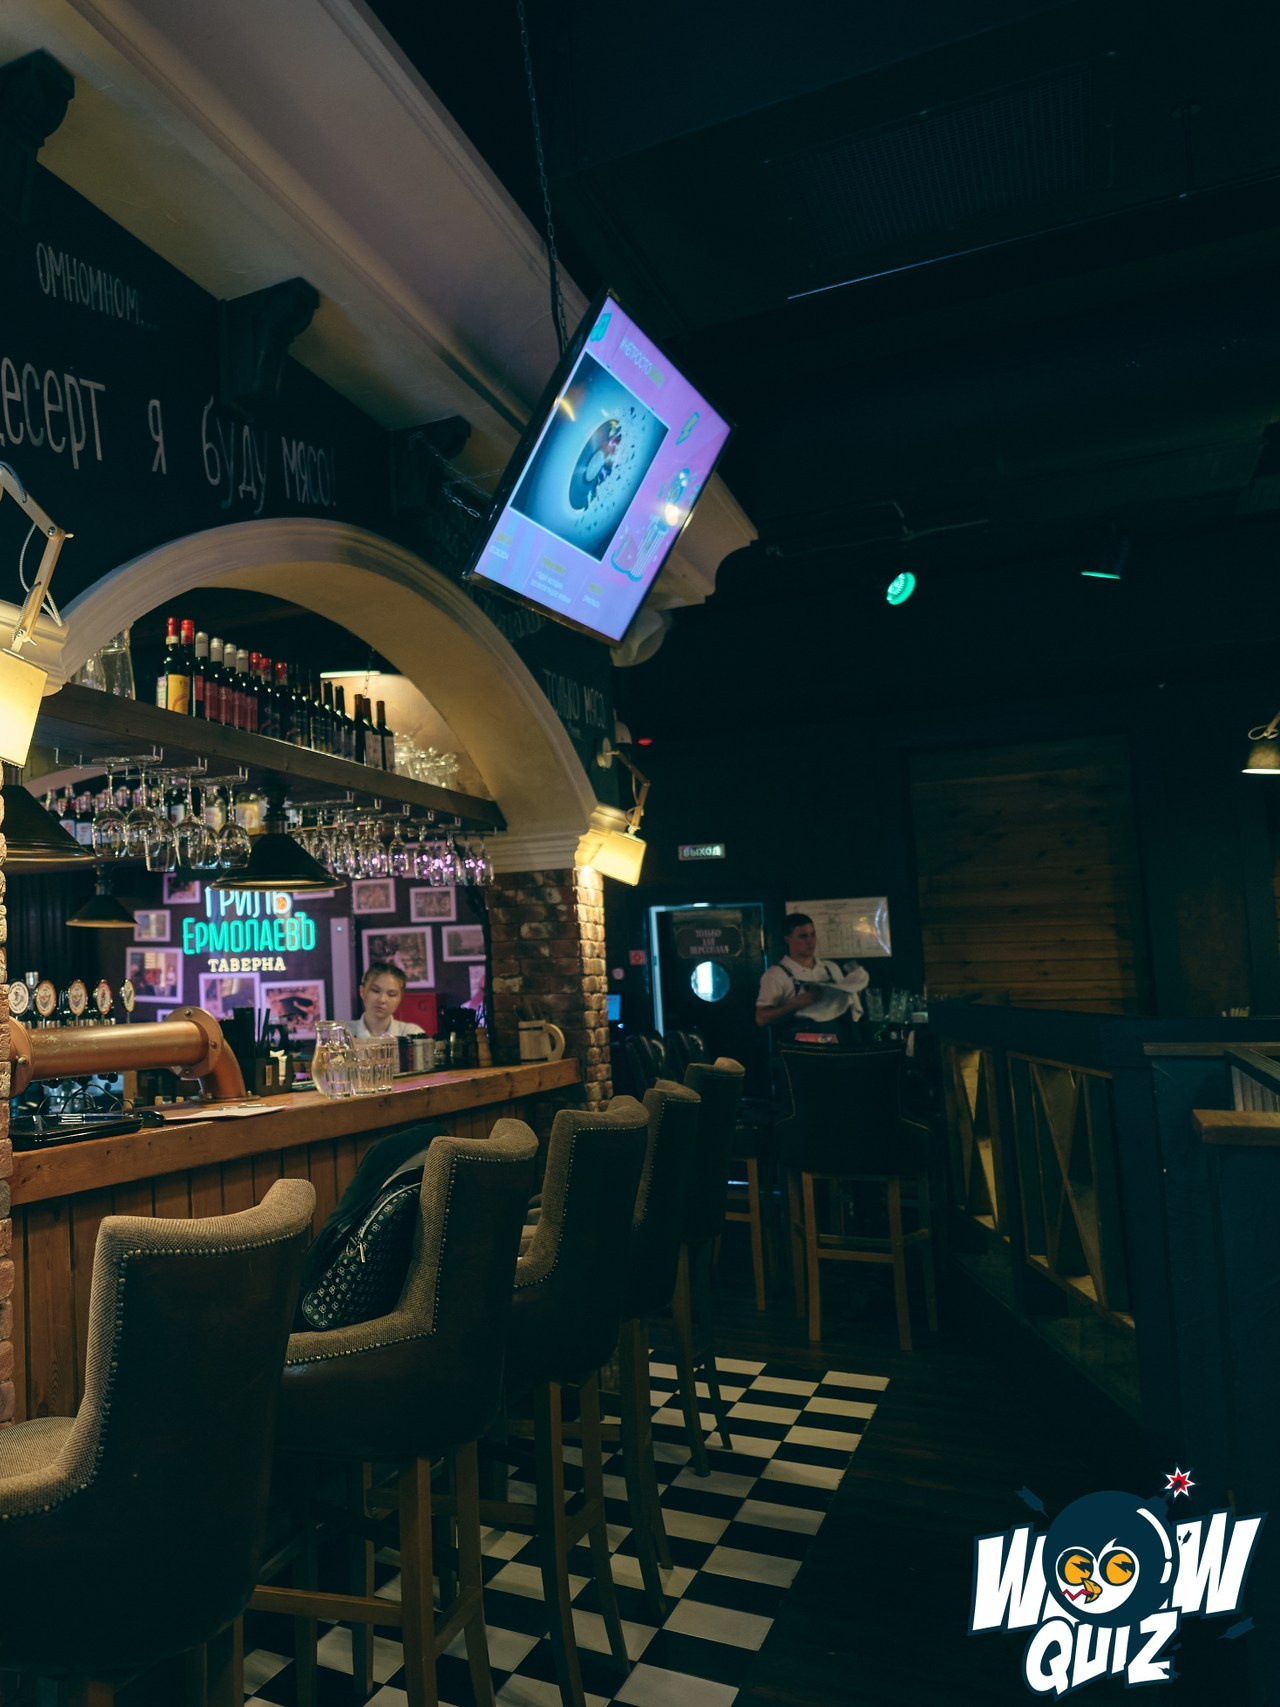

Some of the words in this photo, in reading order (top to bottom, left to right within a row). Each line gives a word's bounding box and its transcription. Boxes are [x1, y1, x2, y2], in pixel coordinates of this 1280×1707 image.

[147, 399, 168, 475] я
[683, 845, 722, 858] ВЫХОД
[207, 955, 287, 973] ТАВЕРНА
